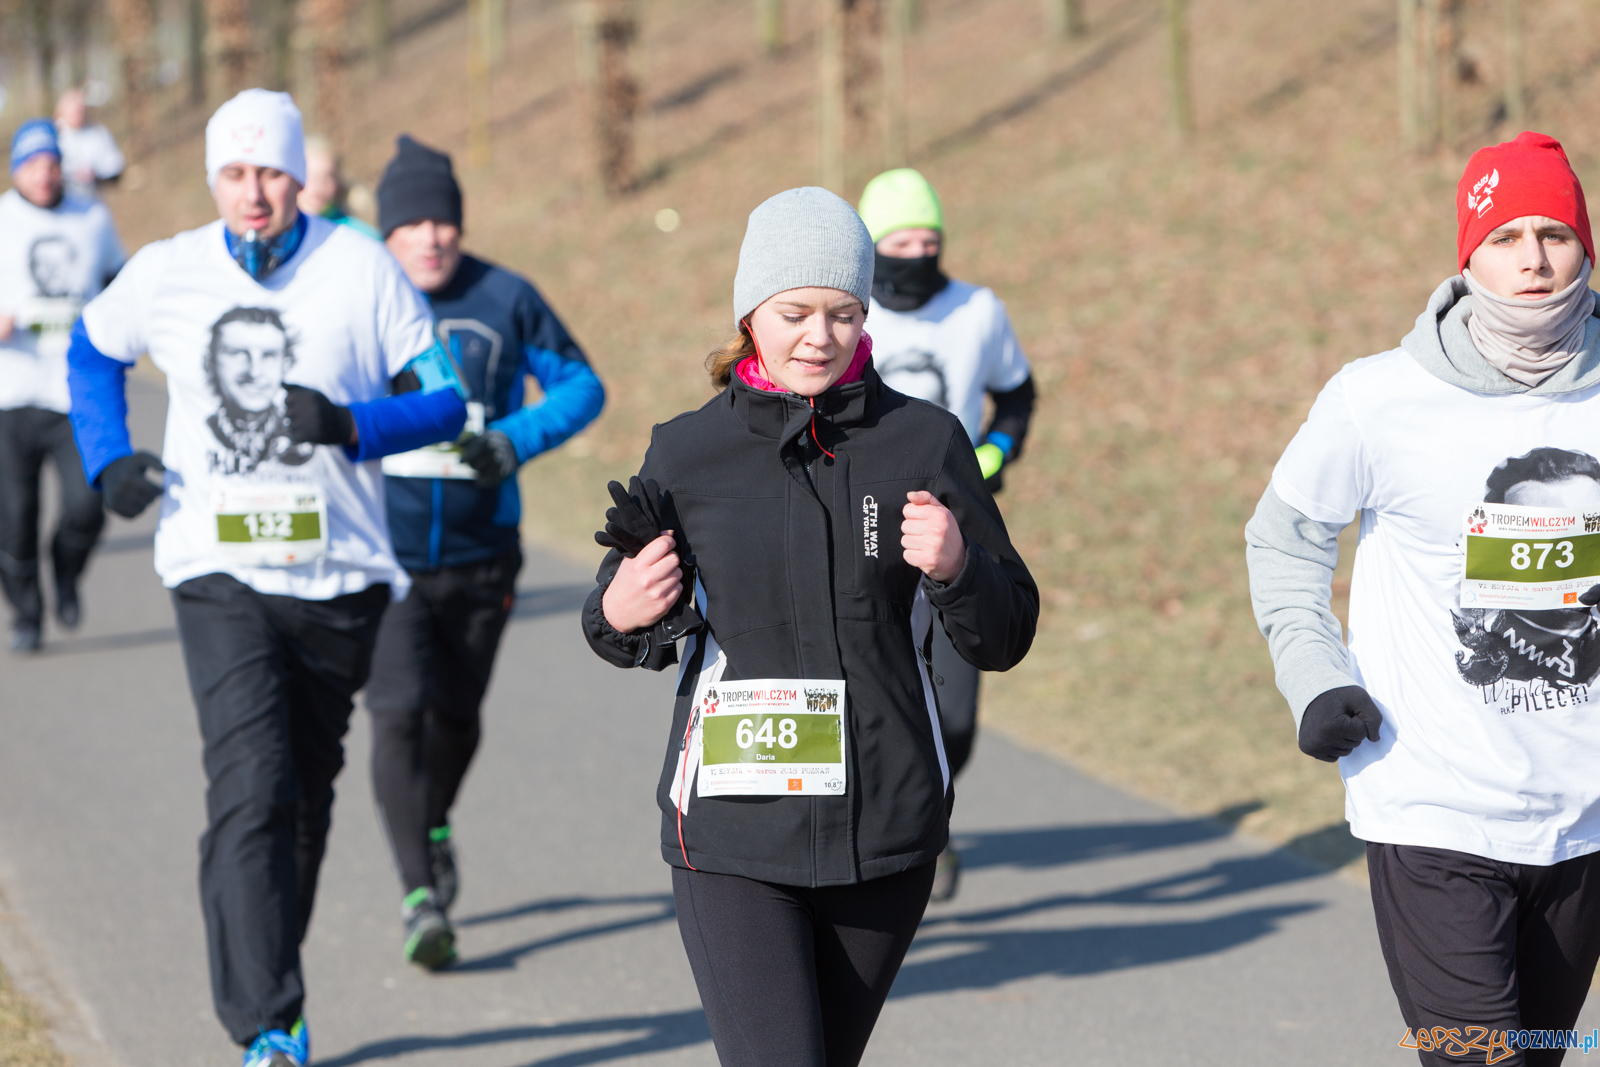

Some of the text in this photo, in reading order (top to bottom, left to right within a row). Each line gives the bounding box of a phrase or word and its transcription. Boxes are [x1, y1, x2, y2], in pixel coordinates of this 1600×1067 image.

[863, 504, 869, 515] OF
[243, 512, 293, 538] 132
[1491, 513, 1576, 528] TROPEMWILCZYM
[869, 530, 878, 559] WAY
[1510, 540, 1575, 570] 873
[1491, 584, 1519, 592] EDYCJA
[722, 689, 797, 703] TROPEMWILCZYM
[736, 718, 798, 749] 648
[756, 753, 776, 761] Daria
